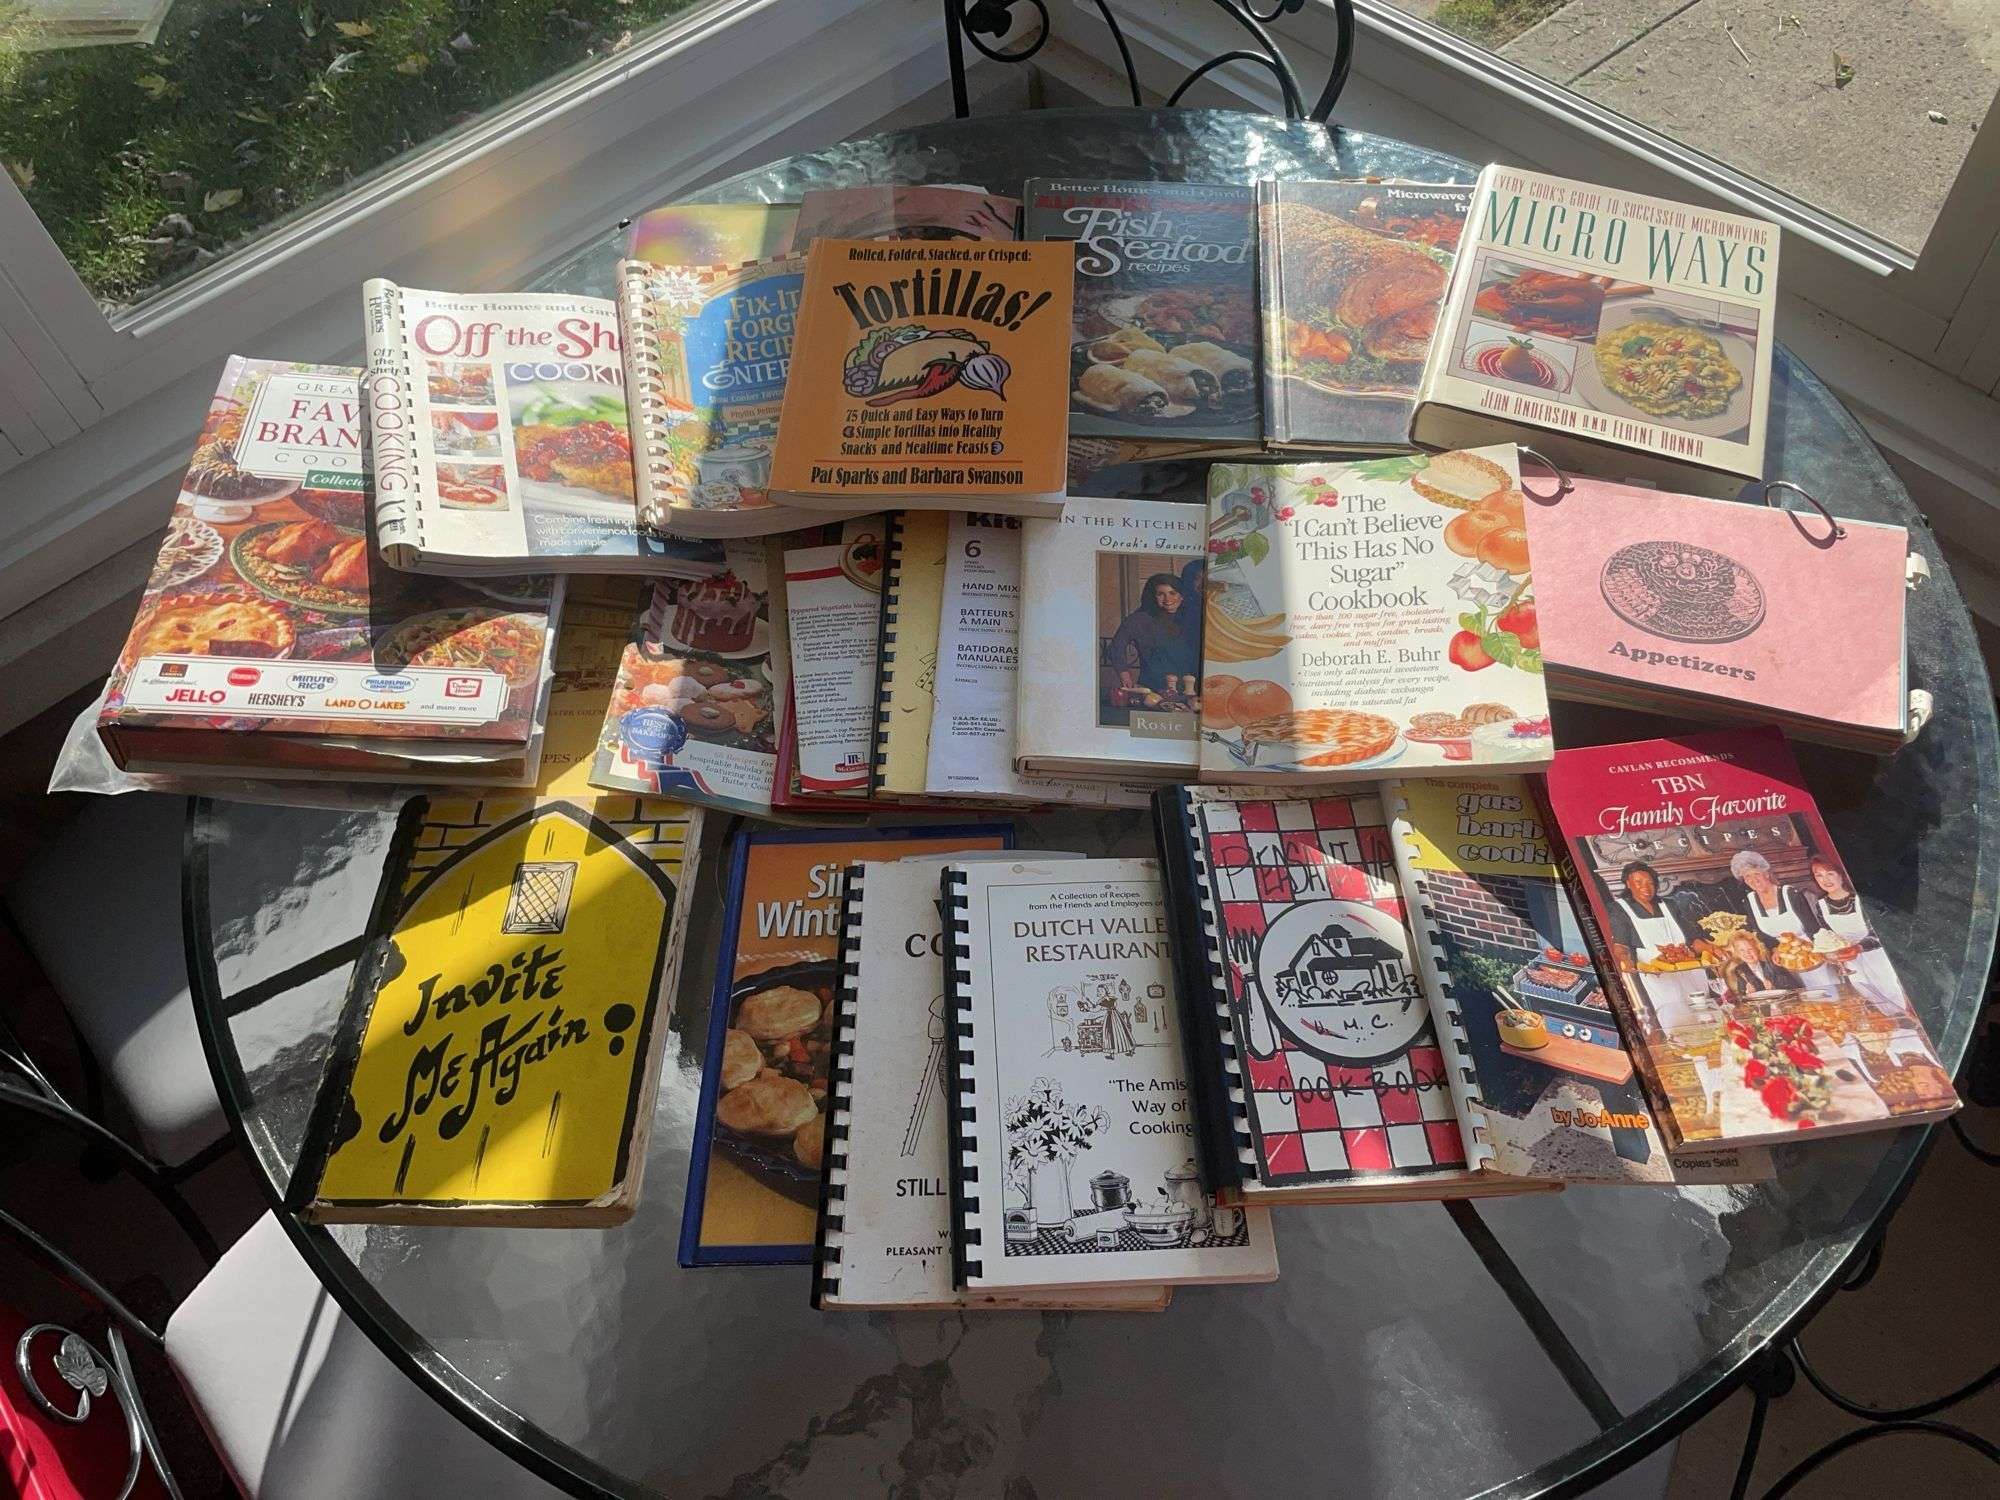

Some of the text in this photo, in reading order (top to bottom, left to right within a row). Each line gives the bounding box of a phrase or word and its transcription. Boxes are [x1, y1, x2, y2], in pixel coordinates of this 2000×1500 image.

[1050, 183, 1099, 193] Better
[1387, 189, 1465, 200] Microwave
[1063, 206, 1175, 243] Fish
[1622, 201, 1687, 229] SUCCESSFUL
[1690, 215, 1768, 245] MICROWAVING
[1479, 190, 1765, 295] MICRO WAYS
[849, 248, 1031, 263] Rolled, Folded, Stacked, or Crisped:
[1076, 235, 1250, 277] Seafood
[1128, 261, 1190, 273] recipes
[730, 289, 800, 319] FIX-IT
[833, 267, 1052, 331] Tortillas!
[483, 302, 540, 312] Homes
[545, 303, 575, 313] and
[415, 315, 502, 357] Off
[505, 327, 552, 346] the
[846, 408, 1003, 422] 75 Quick and Easy Ways to Turn
[1481, 389, 1704, 458] JEAN ANDERSON AND ELAINE HANNA
[374, 377, 408, 491] COOKING
[856, 425, 1002, 439] Simple Tortillas into Healthy
[841, 441, 989, 455] Snacks and Mealtime Feasts
[811, 466, 1024, 487] Pat Sparks and Barbara Swanson
[1342, 494, 1386, 513] The
[1083, 516, 1198, 531] THE KITCHEN
[1304, 516, 1359, 537] Can't
[1364, 513, 1443, 534] Believe
[965, 540, 981, 558] 6
[1100, 535, 1148, 549] Oprah's
[1296, 536, 1434, 561] This Has No
[962, 582, 994, 591] HAND
[1309, 586, 1428, 611] Cookbook
[960, 609, 1014, 618] BATTEURS
[1292, 614, 1312, 622] More
[971, 618, 1001, 626] MAIN
[1354, 619, 1396, 629] recipes for
[958, 644, 1018, 655] BATIDORAS
[1364, 638, 1397, 647] muffins
[957, 654, 1018, 664] MANUALES
[1302, 647, 1441, 667] Deborah E. Buhr
[1608, 641, 1757, 681] Appetizers
[1303, 669, 1320, 677] Uses
[1324, 668, 1342, 677] only
[1395, 664, 1440, 673] sweeteners
[1296, 679, 1342, 688] Nutritional
[1345, 678, 1381, 687] analysis
[1382, 677, 1394, 686] for
[1398, 676, 1421, 685] every
[166, 689, 226, 703] JELL-O
[1311, 685, 1434, 697] including diabetic exchanges
[248, 693, 307, 707] HERSHEY'S
[325, 698, 406, 710] LAND O LAKES
[1330, 696, 1417, 707] Low saturated fat
[1136, 717, 1184, 733] Rosie
[689, 754, 762, 775] hospitable holiday
[760, 759, 773, 767] for
[1608, 752, 1734, 774] CAYLAN RECOMMENDS
[706, 766, 746, 779] featuring
[722, 777, 748, 787] Butter
[1425, 777, 1446, 788] The
[1652, 773, 1707, 795] TBN
[1456, 793, 1523, 815] gas
[1599, 789, 1787, 839] Family Favorite
[1457, 815, 1545, 840] barb
[1058, 892, 1098, 900] Collection
[1100, 891, 1109, 899] of
[1109, 891, 1140, 901] Recipes
[1029, 899, 1153, 910] from the Friends and Employees
[1014, 917, 1168, 938] DUTCH VALLE
[1027, 941, 1172, 962] RESTAURANT
[403, 944, 566, 1038] Invite
[1343, 1017, 1363, 1031] M.
[1371, 1014, 1393, 1029] C.
[379, 1006, 591, 1143] Me Again
[1132, 1099, 1187, 1115] Way of
[1551, 1107, 1650, 1129] by Jo-Anne
[1674, 1157, 1739, 1169] Copies Sold
[896, 1178, 947, 1197] STILL
[886, 1247, 943, 1256] PLEASANT
